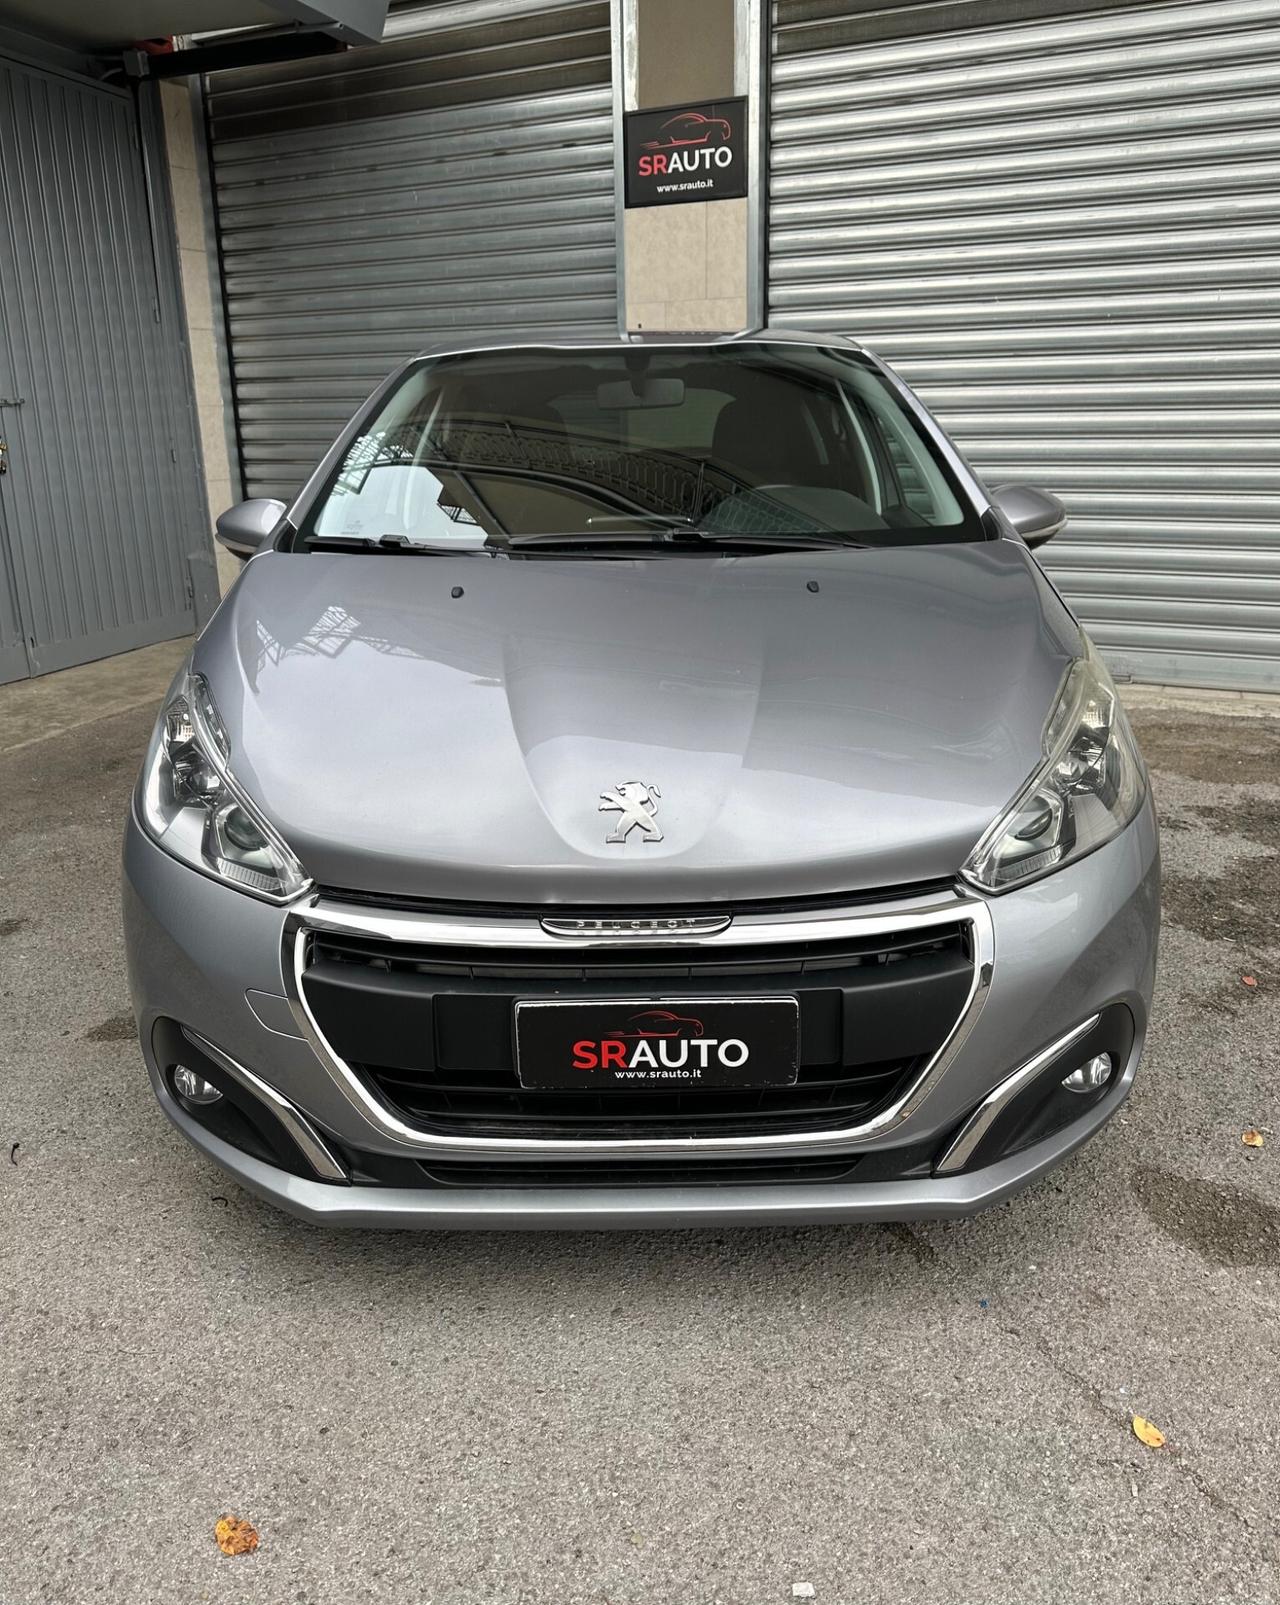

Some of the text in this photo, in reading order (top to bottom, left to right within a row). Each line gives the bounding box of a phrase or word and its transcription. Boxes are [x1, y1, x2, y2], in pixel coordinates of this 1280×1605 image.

[638, 146, 733, 176] SRAUTO
[657, 178, 714, 193] www.srauto.it
[572, 1038, 749, 1069] SRAUTO
[615, 1069, 702, 1079] www.srauto.it
